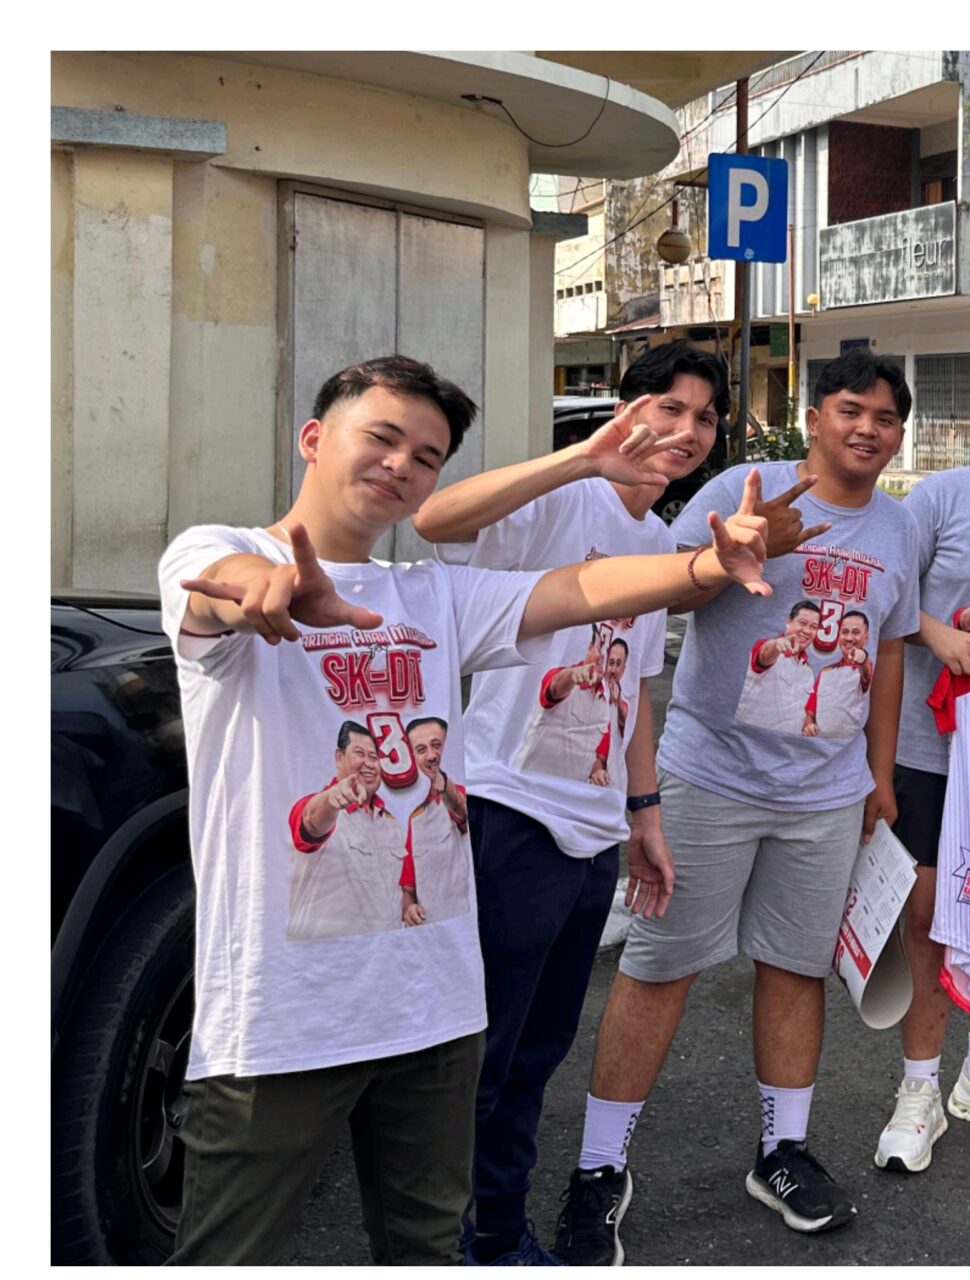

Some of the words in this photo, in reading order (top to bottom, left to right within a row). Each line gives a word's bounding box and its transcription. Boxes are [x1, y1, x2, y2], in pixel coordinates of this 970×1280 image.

[727, 167, 770, 248] P
[801, 558, 872, 602] SK-DT
[301, 632, 351, 650] ARINGAN
[814, 600, 844, 650] 3
[321, 649, 426, 706] SK-DT
[367, 713, 416, 785] 3
